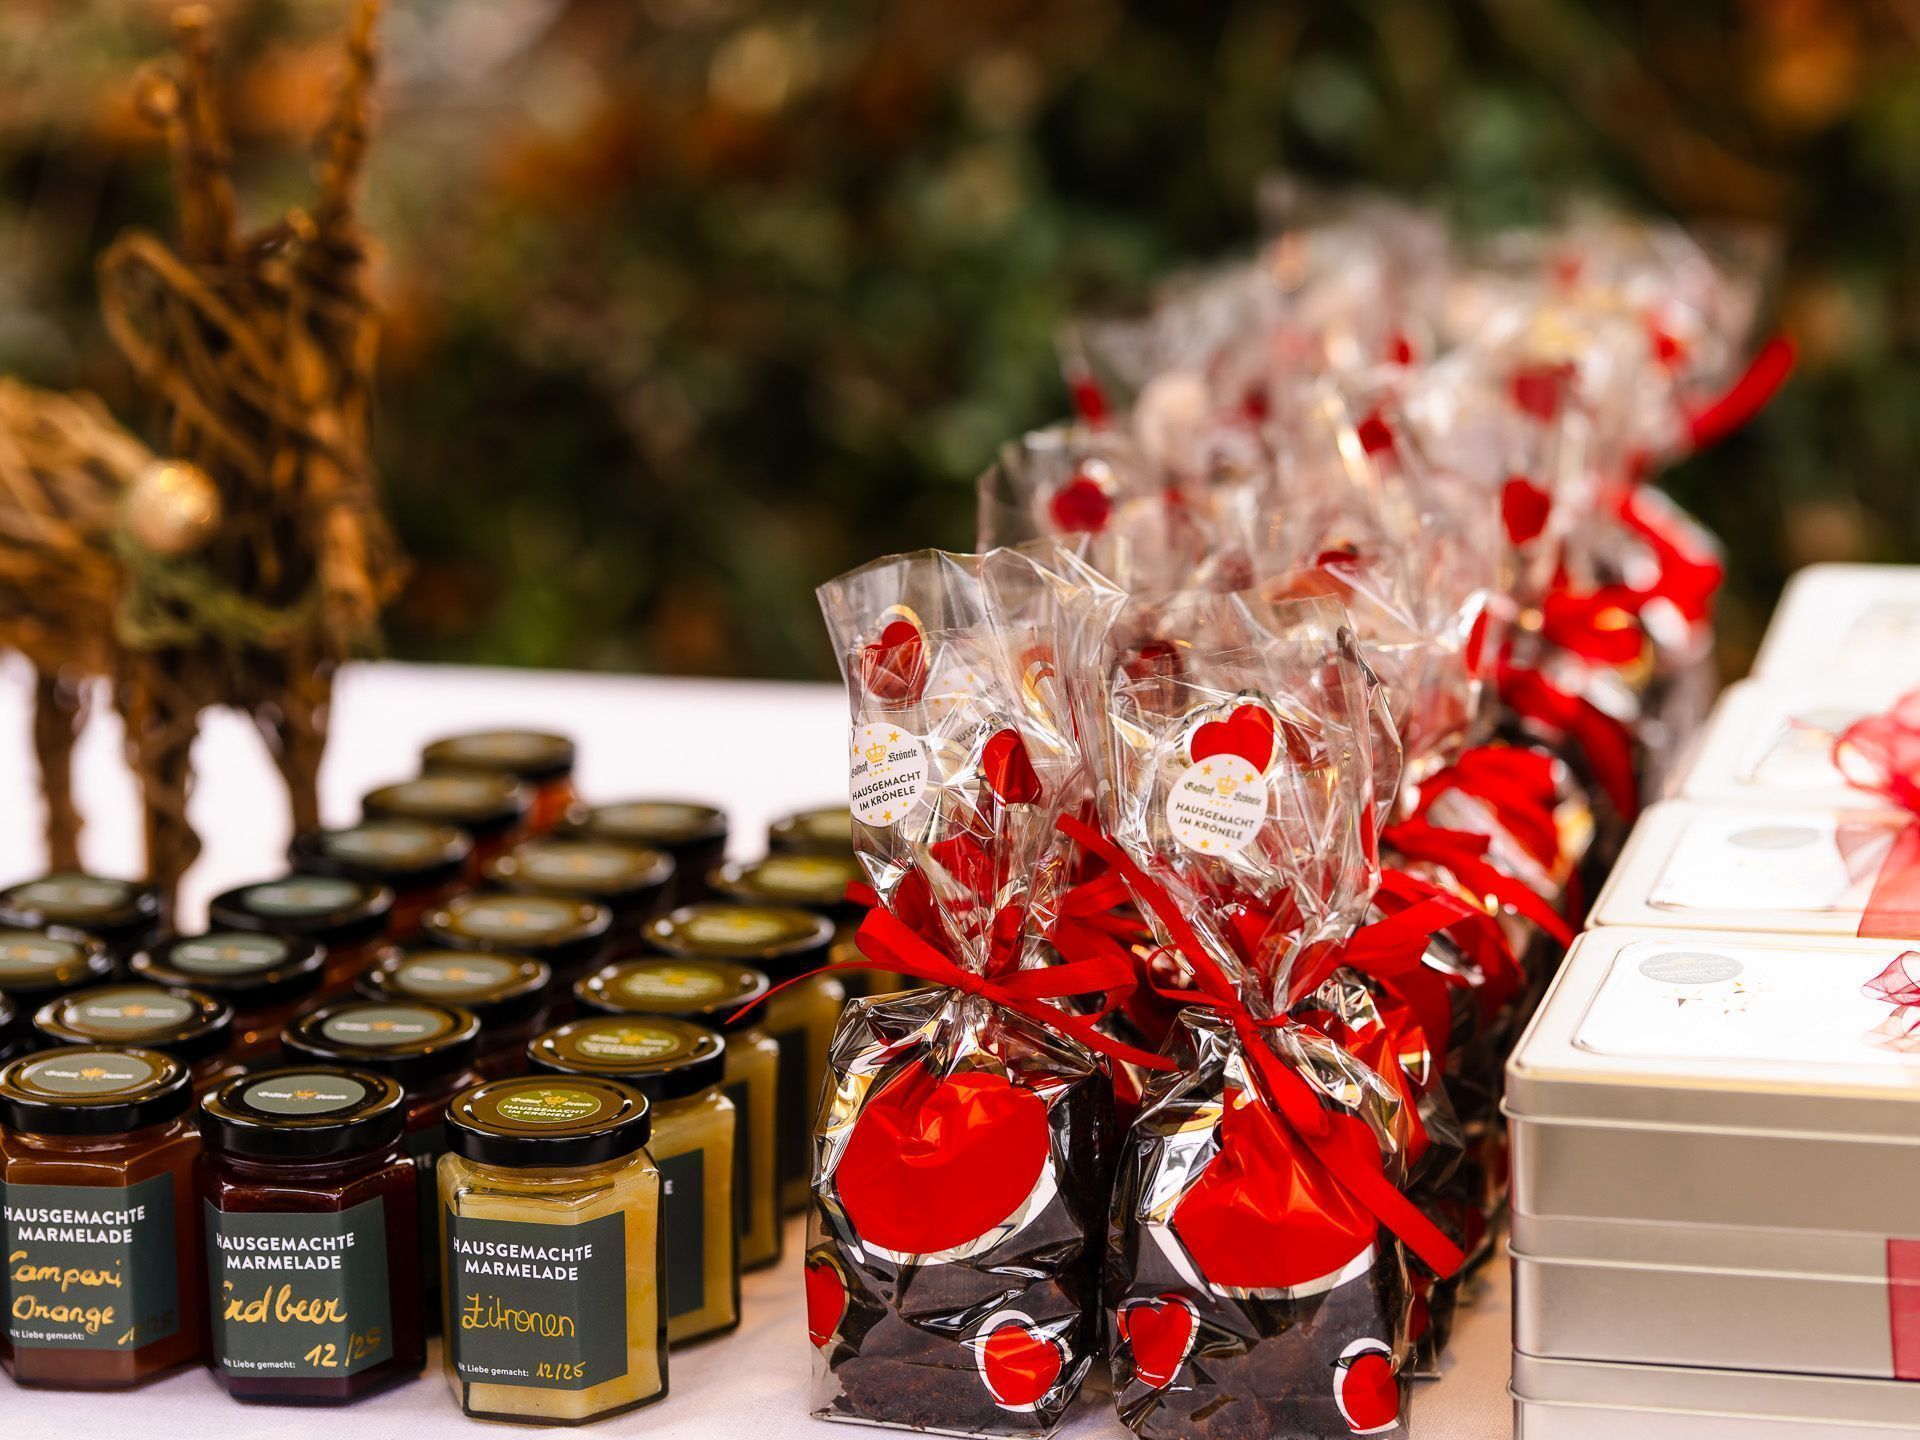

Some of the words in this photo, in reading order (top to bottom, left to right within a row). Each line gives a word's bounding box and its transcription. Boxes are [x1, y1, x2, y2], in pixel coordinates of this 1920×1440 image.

[852, 771, 921, 801] HAUSGEMACHT
[859, 802, 870, 811] IM
[871, 786, 916, 806] KRÖNELE
[1176, 802, 1255, 828] HAUSGEMACHT
[1179, 816, 1192, 824] IM
[504, 1104, 586, 1115] HAUSGEMACHT
[3, 1205, 145, 1225] HAUSGEMACHTE
[18, 1226, 133, 1244] MARMELADE
[216, 1232, 355, 1251] HAUSGEMACHTE
[453, 1236, 593, 1263] HAUSGEMACHTE
[9, 1250, 122, 1293] Campari
[226, 1255, 342, 1270] MARMELADE
[465, 1259, 579, 1281] MARMELADE
[12, 1294, 115, 1335] Orange
[461, 1292, 575, 1338] Zitronen
[21, 1330, 44, 1339] Liebe
[45, 1331, 85, 1344] gemacht:
[233, 1358, 255, 1369] Liebe
[256, 1360, 296, 1371] gemacht:
[467, 1364, 489, 1374] Liebe
[491, 1367, 529, 1377] gemacht:
[536, 1361, 587, 1381] 12/25
